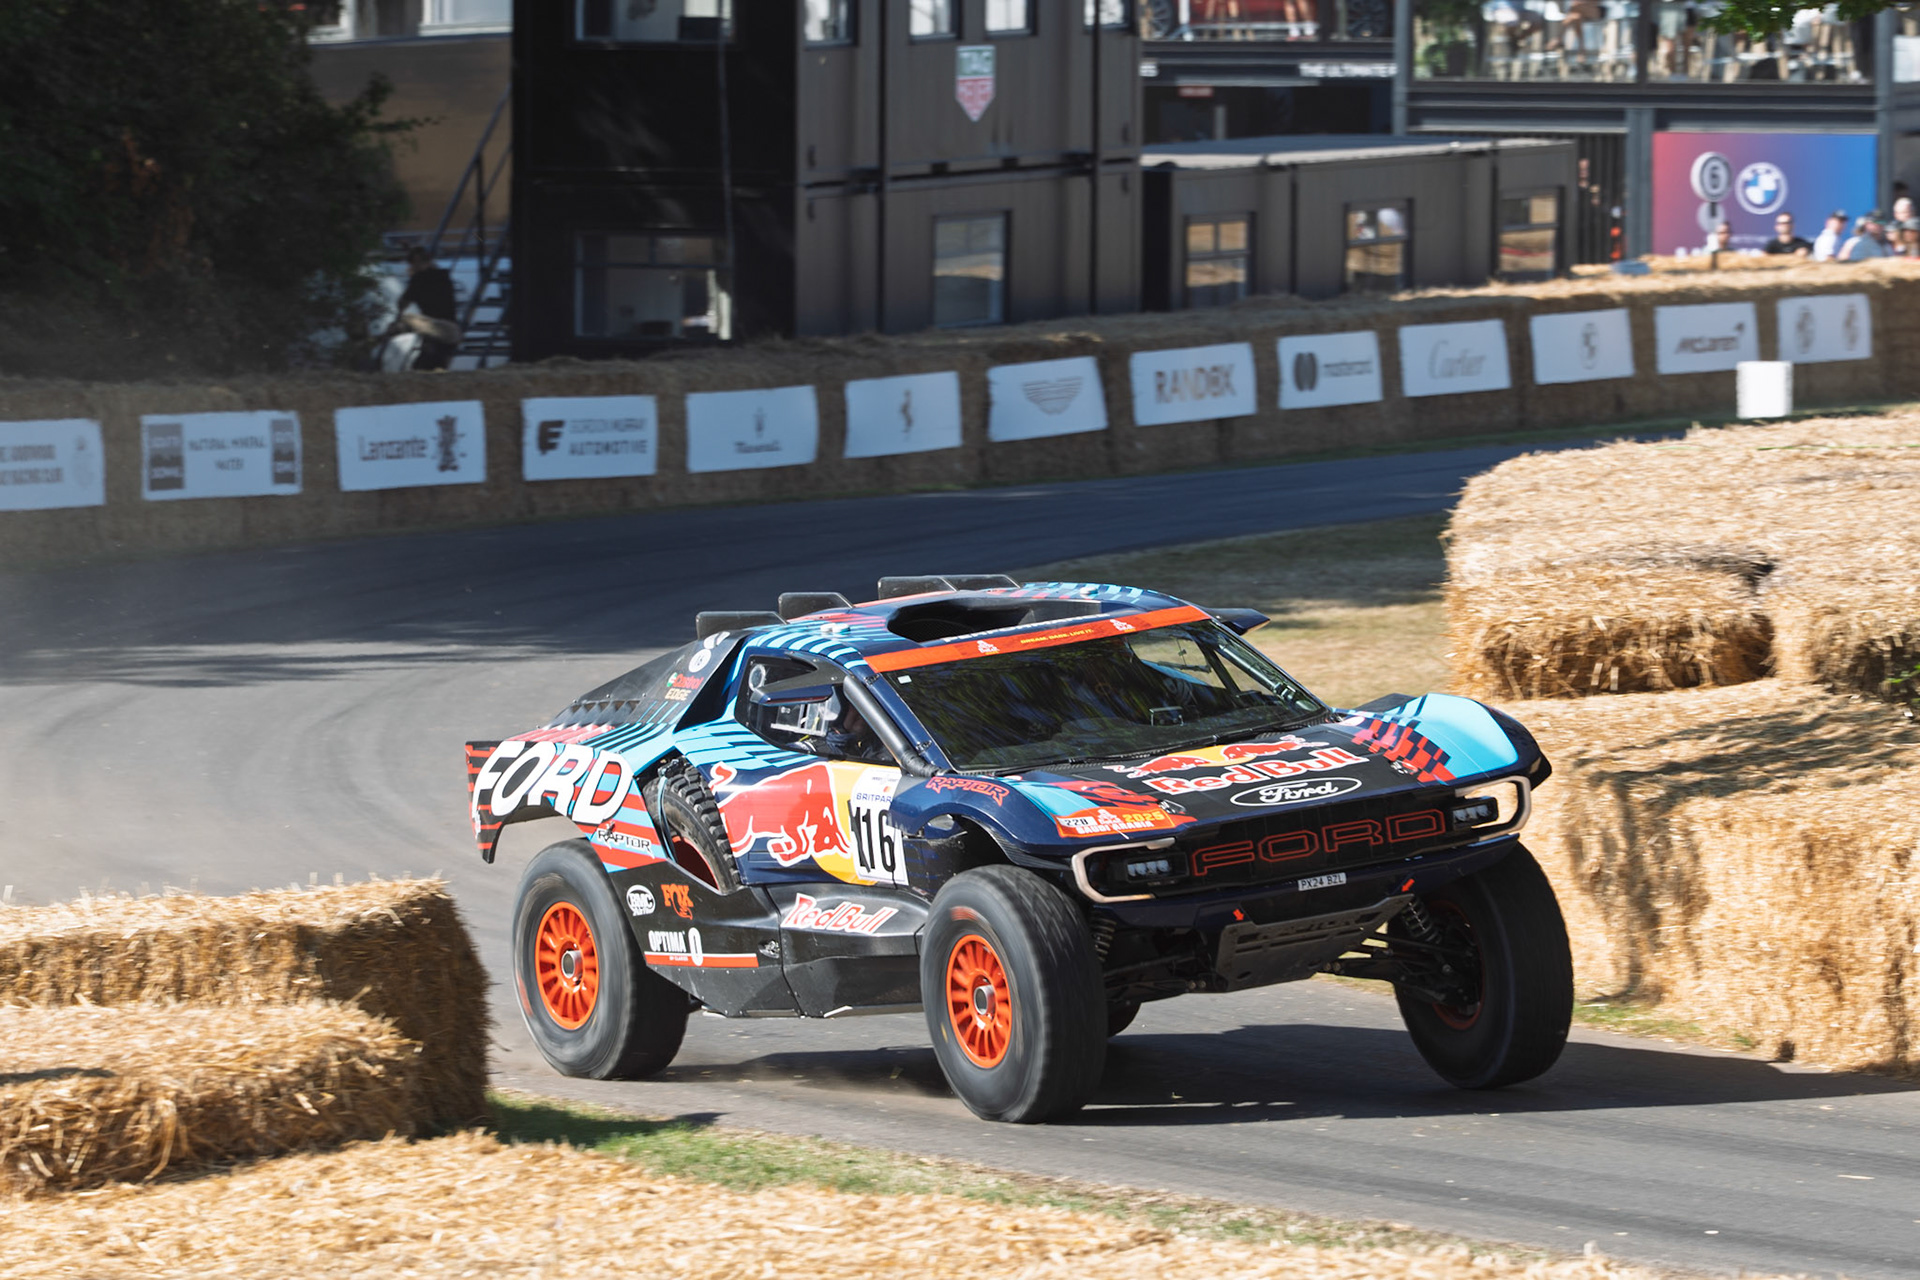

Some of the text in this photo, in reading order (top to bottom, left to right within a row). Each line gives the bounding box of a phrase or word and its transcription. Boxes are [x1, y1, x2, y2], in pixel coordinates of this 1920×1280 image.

[1299, 63, 1325, 77] THE
[664, 688, 692, 701] EDGE
[1142, 746, 1370, 795] Red Bull
[472, 740, 633, 825] FORD
[925, 776, 1010, 807] RAPTOR
[1258, 781, 1338, 803] Ford
[856, 792, 893, 803] BRITPAR
[1075, 825, 1111, 835] SAUDI
[1111, 820, 1155, 831] ARABIA
[1122, 811, 1165, 823] 2025
[597, 826, 656, 859] RAPTOR
[1192, 809, 1446, 877] FORD
[1301, 874, 1345, 889] PX24 BZL
[629, 892, 654, 909] BMC
[661, 883, 694, 911] FOX
[780, 893, 899, 935] Red Bull
[648, 930, 687, 953] OPTIMA
